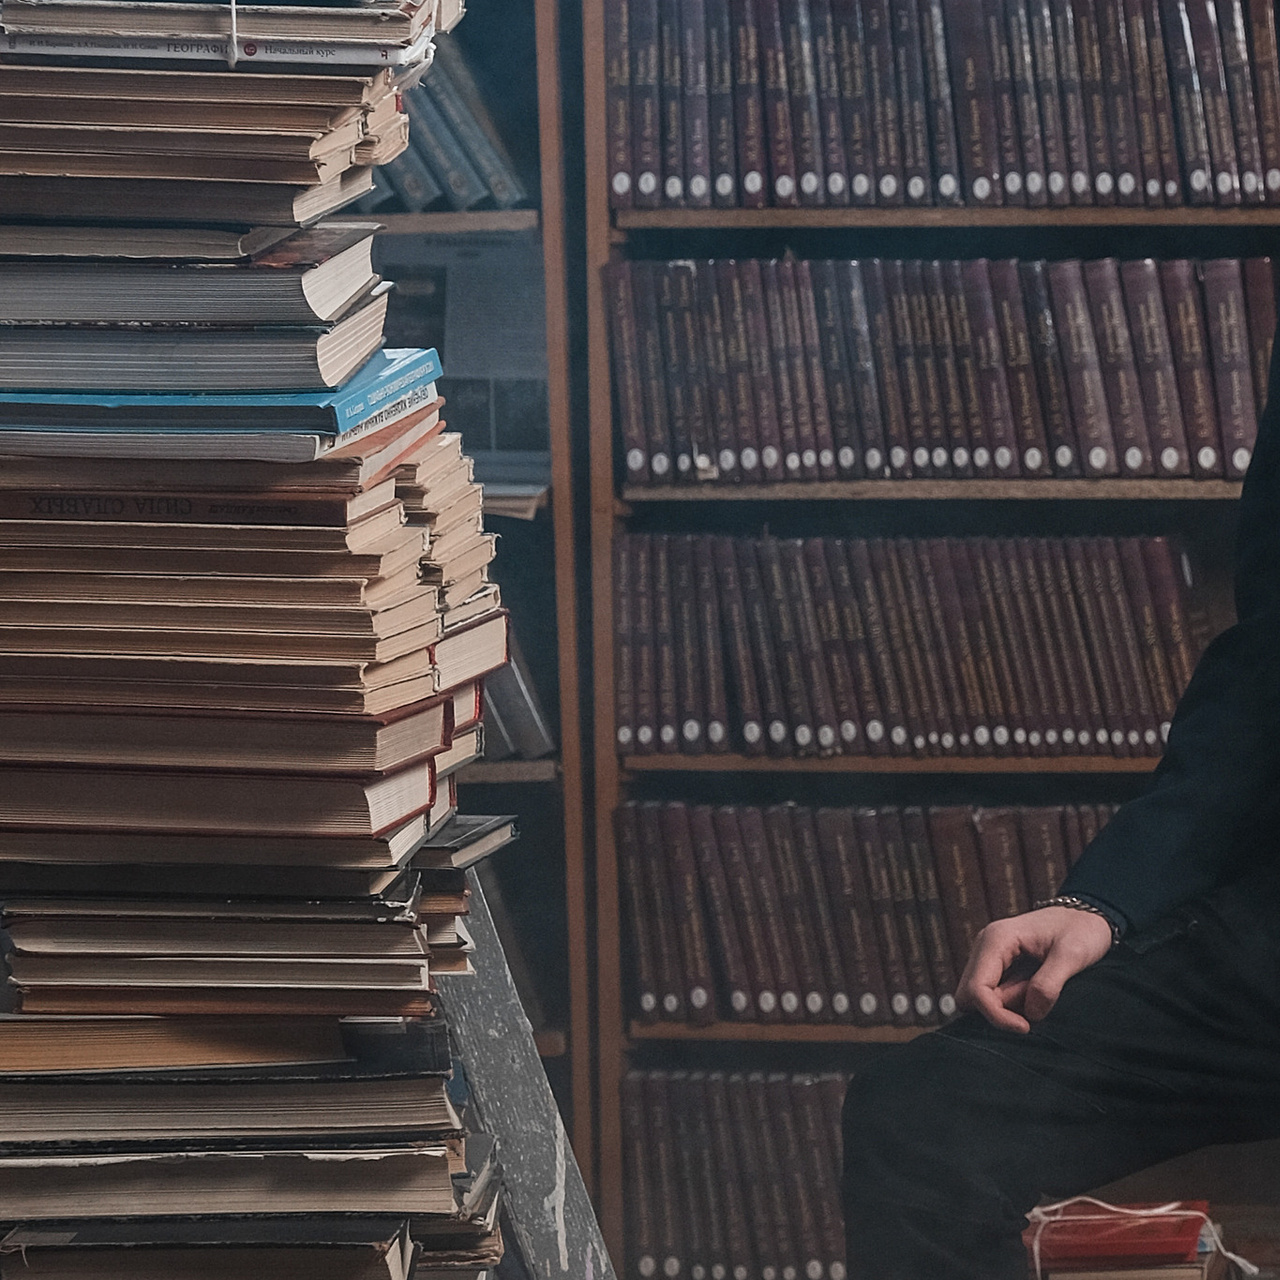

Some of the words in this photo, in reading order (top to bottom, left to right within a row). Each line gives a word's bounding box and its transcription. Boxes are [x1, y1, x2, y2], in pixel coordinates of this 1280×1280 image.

[166, 41, 231, 55] ГЕОГРАФИ
[264, 45, 312, 57] Начальный
[314, 47, 336, 59] курс
[135, 497, 192, 522] СИЛА
